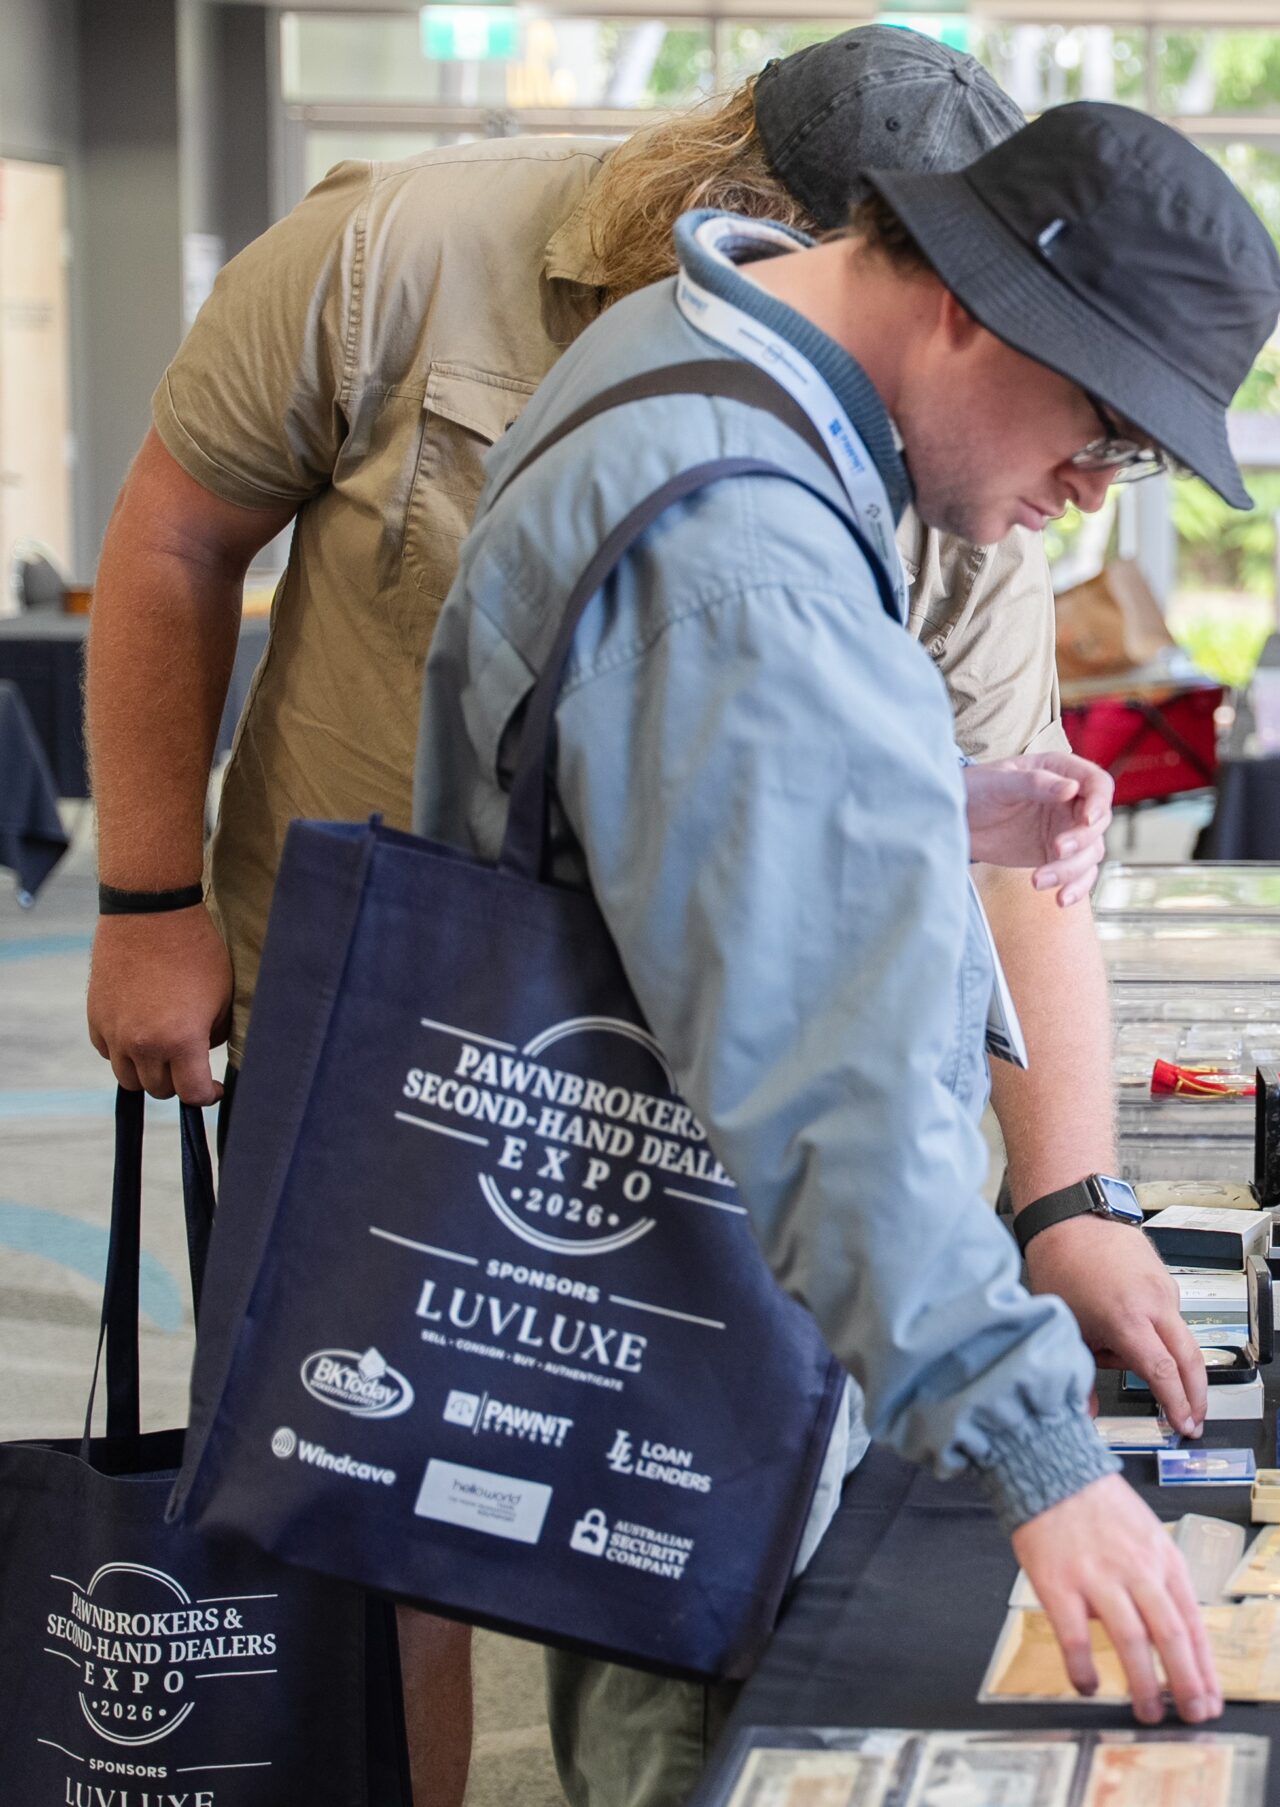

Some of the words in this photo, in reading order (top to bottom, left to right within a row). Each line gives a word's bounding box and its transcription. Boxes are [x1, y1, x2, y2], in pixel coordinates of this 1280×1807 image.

[454, 1043, 707, 1142] PAWNBROKERS
[403, 1068, 635, 1158] SECOND-HAND
[638, 1138, 737, 1188] DEALE
[498, 1135, 652, 1202] EXPO
[525, 1188, 602, 1228] 2026
[486, 1258, 601, 1304] SPONSORS
[416, 1279, 648, 1374] LUVLUXE
[313, 1357, 400, 1404] BKToday
[298, 1438, 397, 1486] Windcave
[640, 1440, 693, 1468] LOAN
[635, 1459, 712, 1493] LENDERS
[609, 1532, 689, 1565] SECURITY
[614, 1520, 694, 1550] AUSTRALIAN
[605, 1548, 685, 1580] COMPANY
[72, 1591, 219, 1637] PAWNBROKERS
[223, 1607, 243, 1629] &
[47, 1613, 162, 1664] SECOND-HAND
[168, 1633, 277, 1662] DEALERS
[84, 1660, 184, 1694] EXPO
[100, 1700, 153, 1721] 2026
[89, 1758, 168, 1778] SPONSORS
